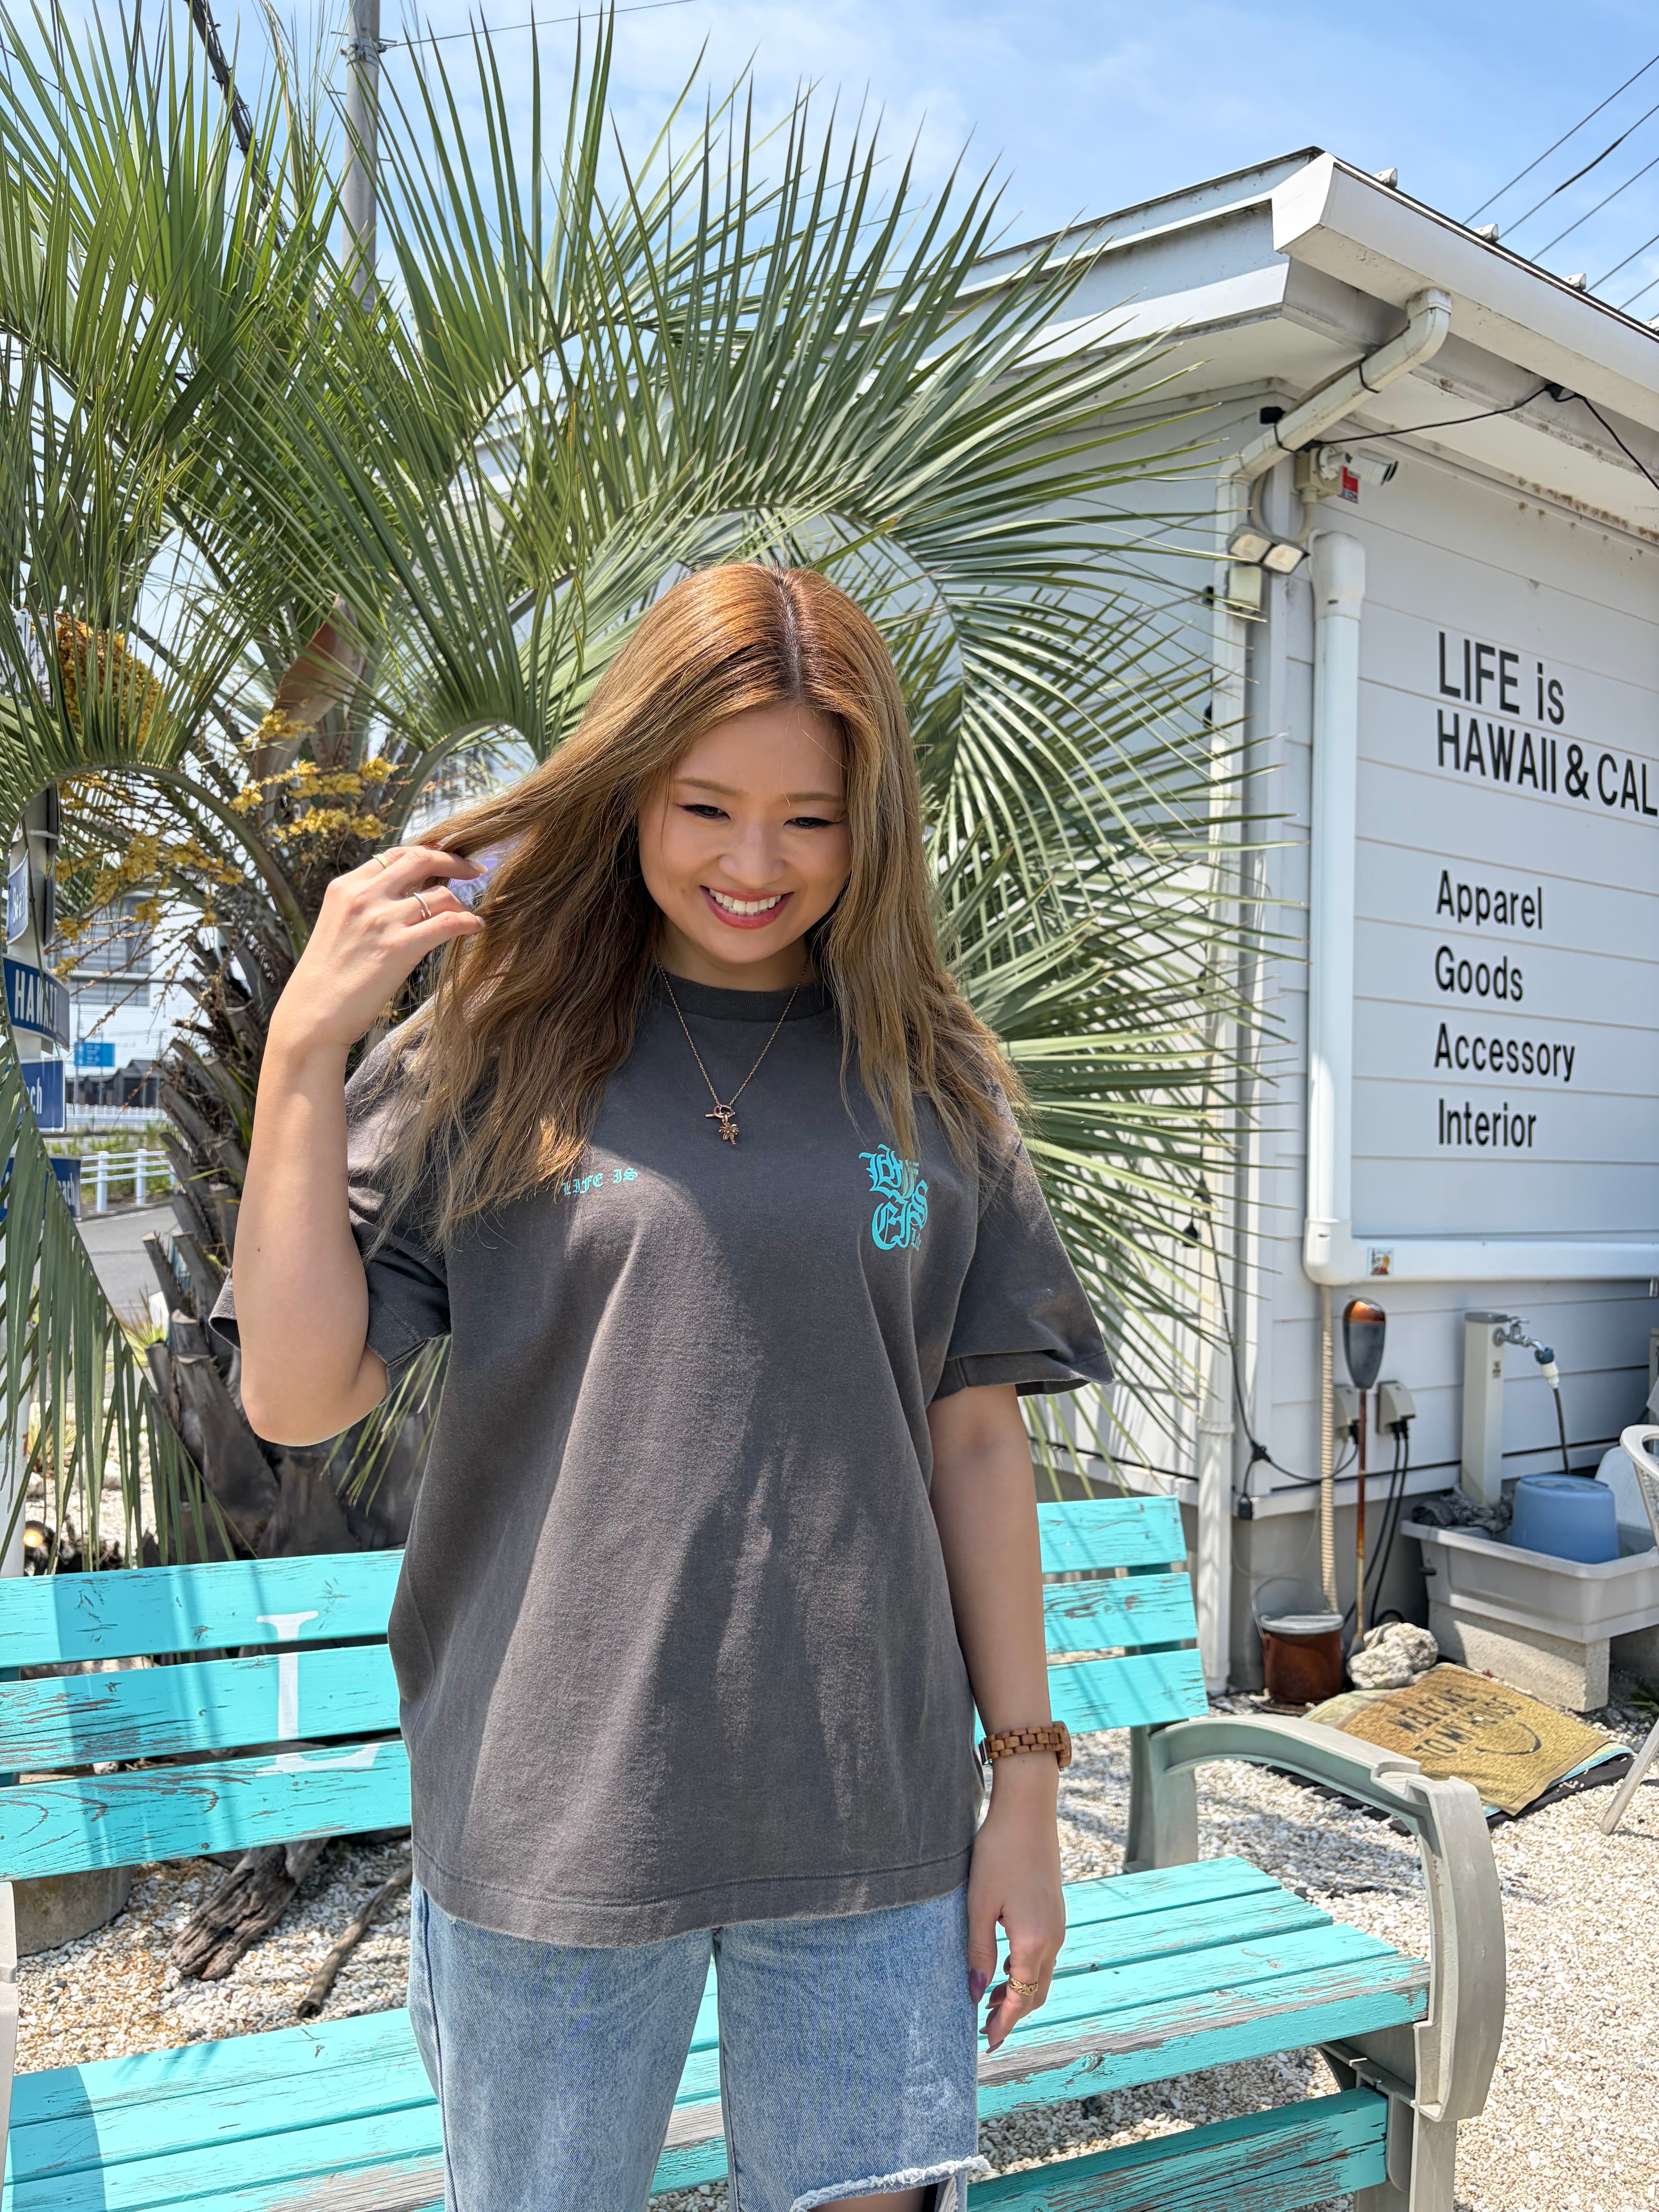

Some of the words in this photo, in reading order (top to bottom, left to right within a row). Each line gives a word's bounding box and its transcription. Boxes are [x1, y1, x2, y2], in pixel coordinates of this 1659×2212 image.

[1438, 630, 1520, 715] LIFE
[1537, 661, 1565, 725] is
[1437, 709, 1557, 795] HAWAII
[1565, 743, 1590, 800] &
[1597, 752, 1658, 817] CAL
[1436, 869, 1543, 930] Apparel
[1434, 944, 1523, 1002] Goods
[1434, 1022, 1575, 1083] Accessory
[1439, 1098, 1537, 1148] Interior
[562, 1173, 604, 1196] LIFE
